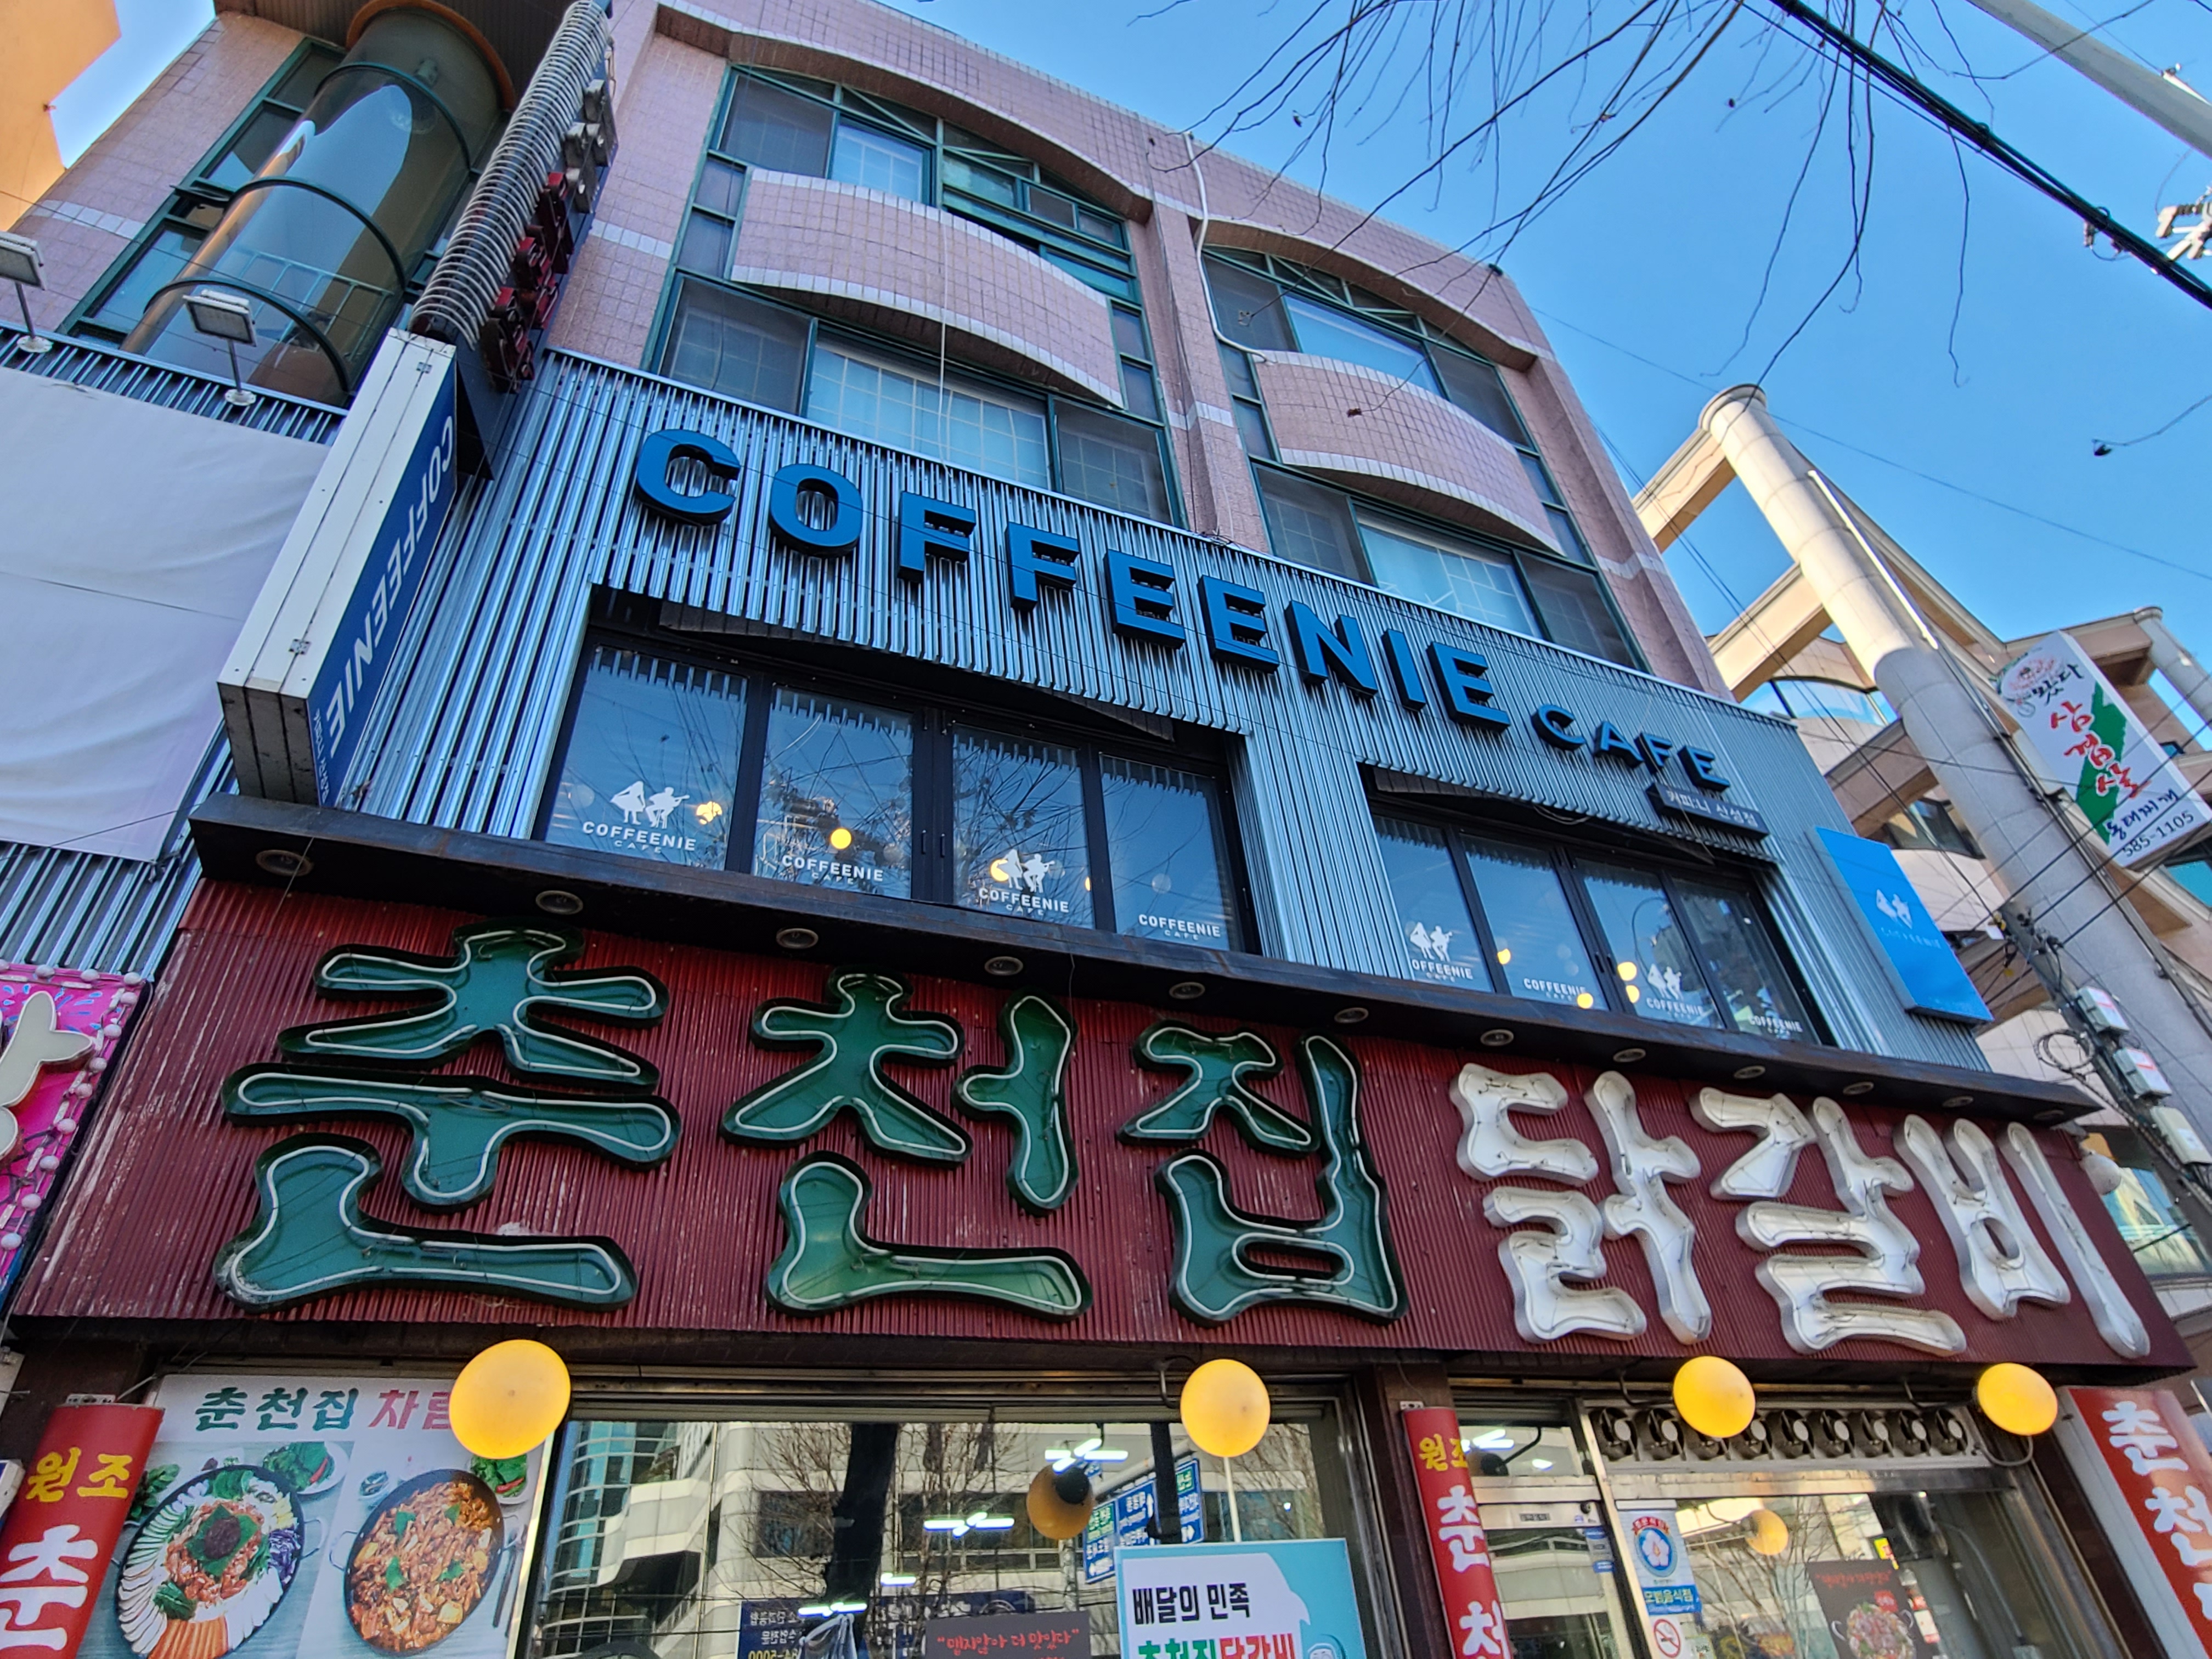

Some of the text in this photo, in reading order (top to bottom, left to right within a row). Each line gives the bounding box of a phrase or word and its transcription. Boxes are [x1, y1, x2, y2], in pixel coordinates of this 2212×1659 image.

[326, 415, 453, 759] COFFEENIE
[636, 428, 1731, 792] COFFEENIE CAFE
[2050, 699, 2152, 799] 삼겹살
[582, 821, 696, 851] COFFEENIE
[614, 839, 662, 854] CAFE
[2123, 810, 2194, 857] 585-1105
[781, 854, 884, 882] COFFEENIE
[811, 871, 854, 885] CAFE
[979, 887, 1069, 913] COFFEENIE
[1006, 904, 1044, 916] CAFE
[1138, 913, 1221, 938] COFFEENIE
[1164, 929, 1199, 940] CAFE
[1412, 960, 1474, 980] OFFEENIE
[1523, 978, 1586, 995] COFFEENIE
[1646, 997, 1704, 1015] COFFEENIE
[1748, 1015, 1804, 1033] COFFEENIE
[212, 917, 1410, 1329] 춘천집
[1449, 1062, 2151, 1360] 닭갈비
[195, 1387, 359, 1431] 춘천집
[26, 1446, 134, 1503] 원조
[2102, 1401, 2212, 1621] 춘천
[0, 1524, 99, 1651] 춘
[1132, 1582, 1251, 1625] 배달의 민족
